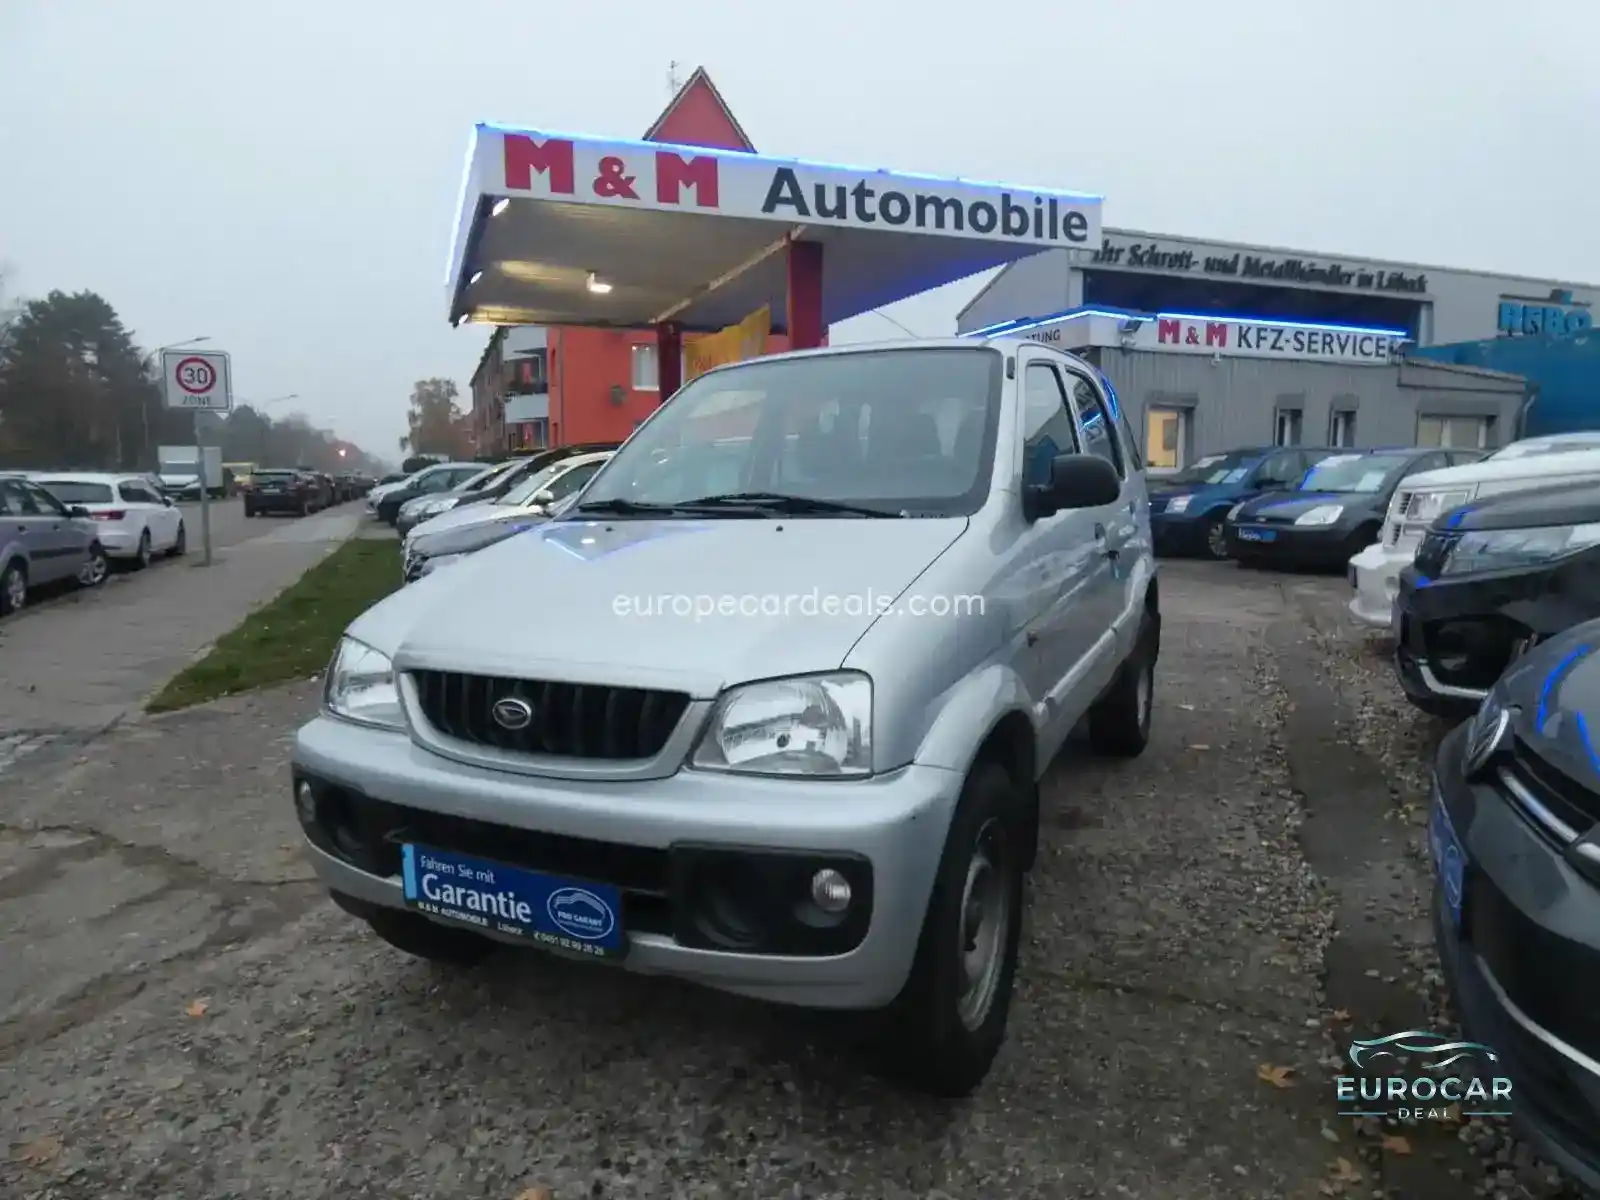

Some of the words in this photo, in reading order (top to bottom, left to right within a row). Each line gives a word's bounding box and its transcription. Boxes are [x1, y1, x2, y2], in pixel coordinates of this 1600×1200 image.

[503, 133, 575, 195] M
[592, 155, 641, 200] &
[655, 151, 720, 208] M
[762, 166, 1089, 243] Automobile
[1203, 252, 1239, 274] und
[1157, 319, 1181, 344] M
[1184, 326, 1200, 345] &
[1206, 322, 1228, 348] M
[1236, 325, 1388, 359] KFZ-SERVICE
[184, 367, 208, 384] 30
[420, 855, 455, 874] Fahren
[457, 863, 474, 877] Sie
[475, 869, 496, 884] mit
[421, 873, 532, 923] Garantie
